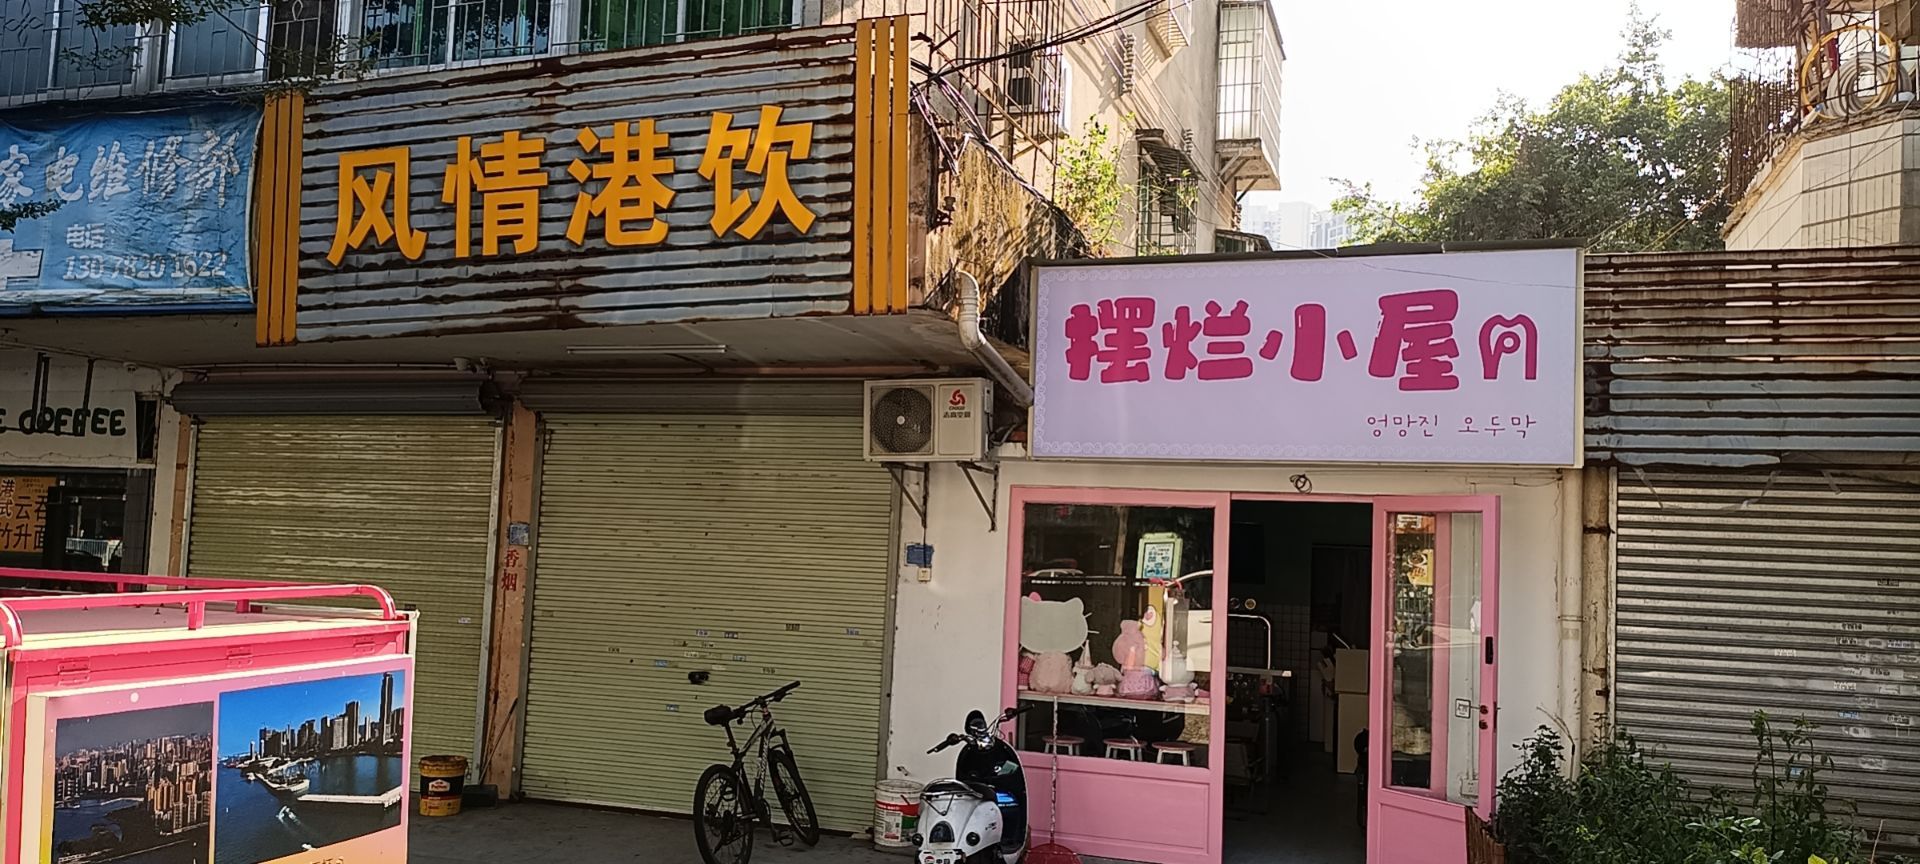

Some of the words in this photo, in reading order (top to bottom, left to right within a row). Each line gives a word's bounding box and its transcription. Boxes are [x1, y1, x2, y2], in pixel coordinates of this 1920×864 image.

[327, 105, 816, 266] 风情港饮
[1065, 289, 1460, 391] 摆烂小屋
[18, 407, 126, 437] COFFEE
[1367, 414, 1438, 438] 엉망진
[1458, 414, 1537, 439] 오두막
[501, 549, 519, 592] 香烟
